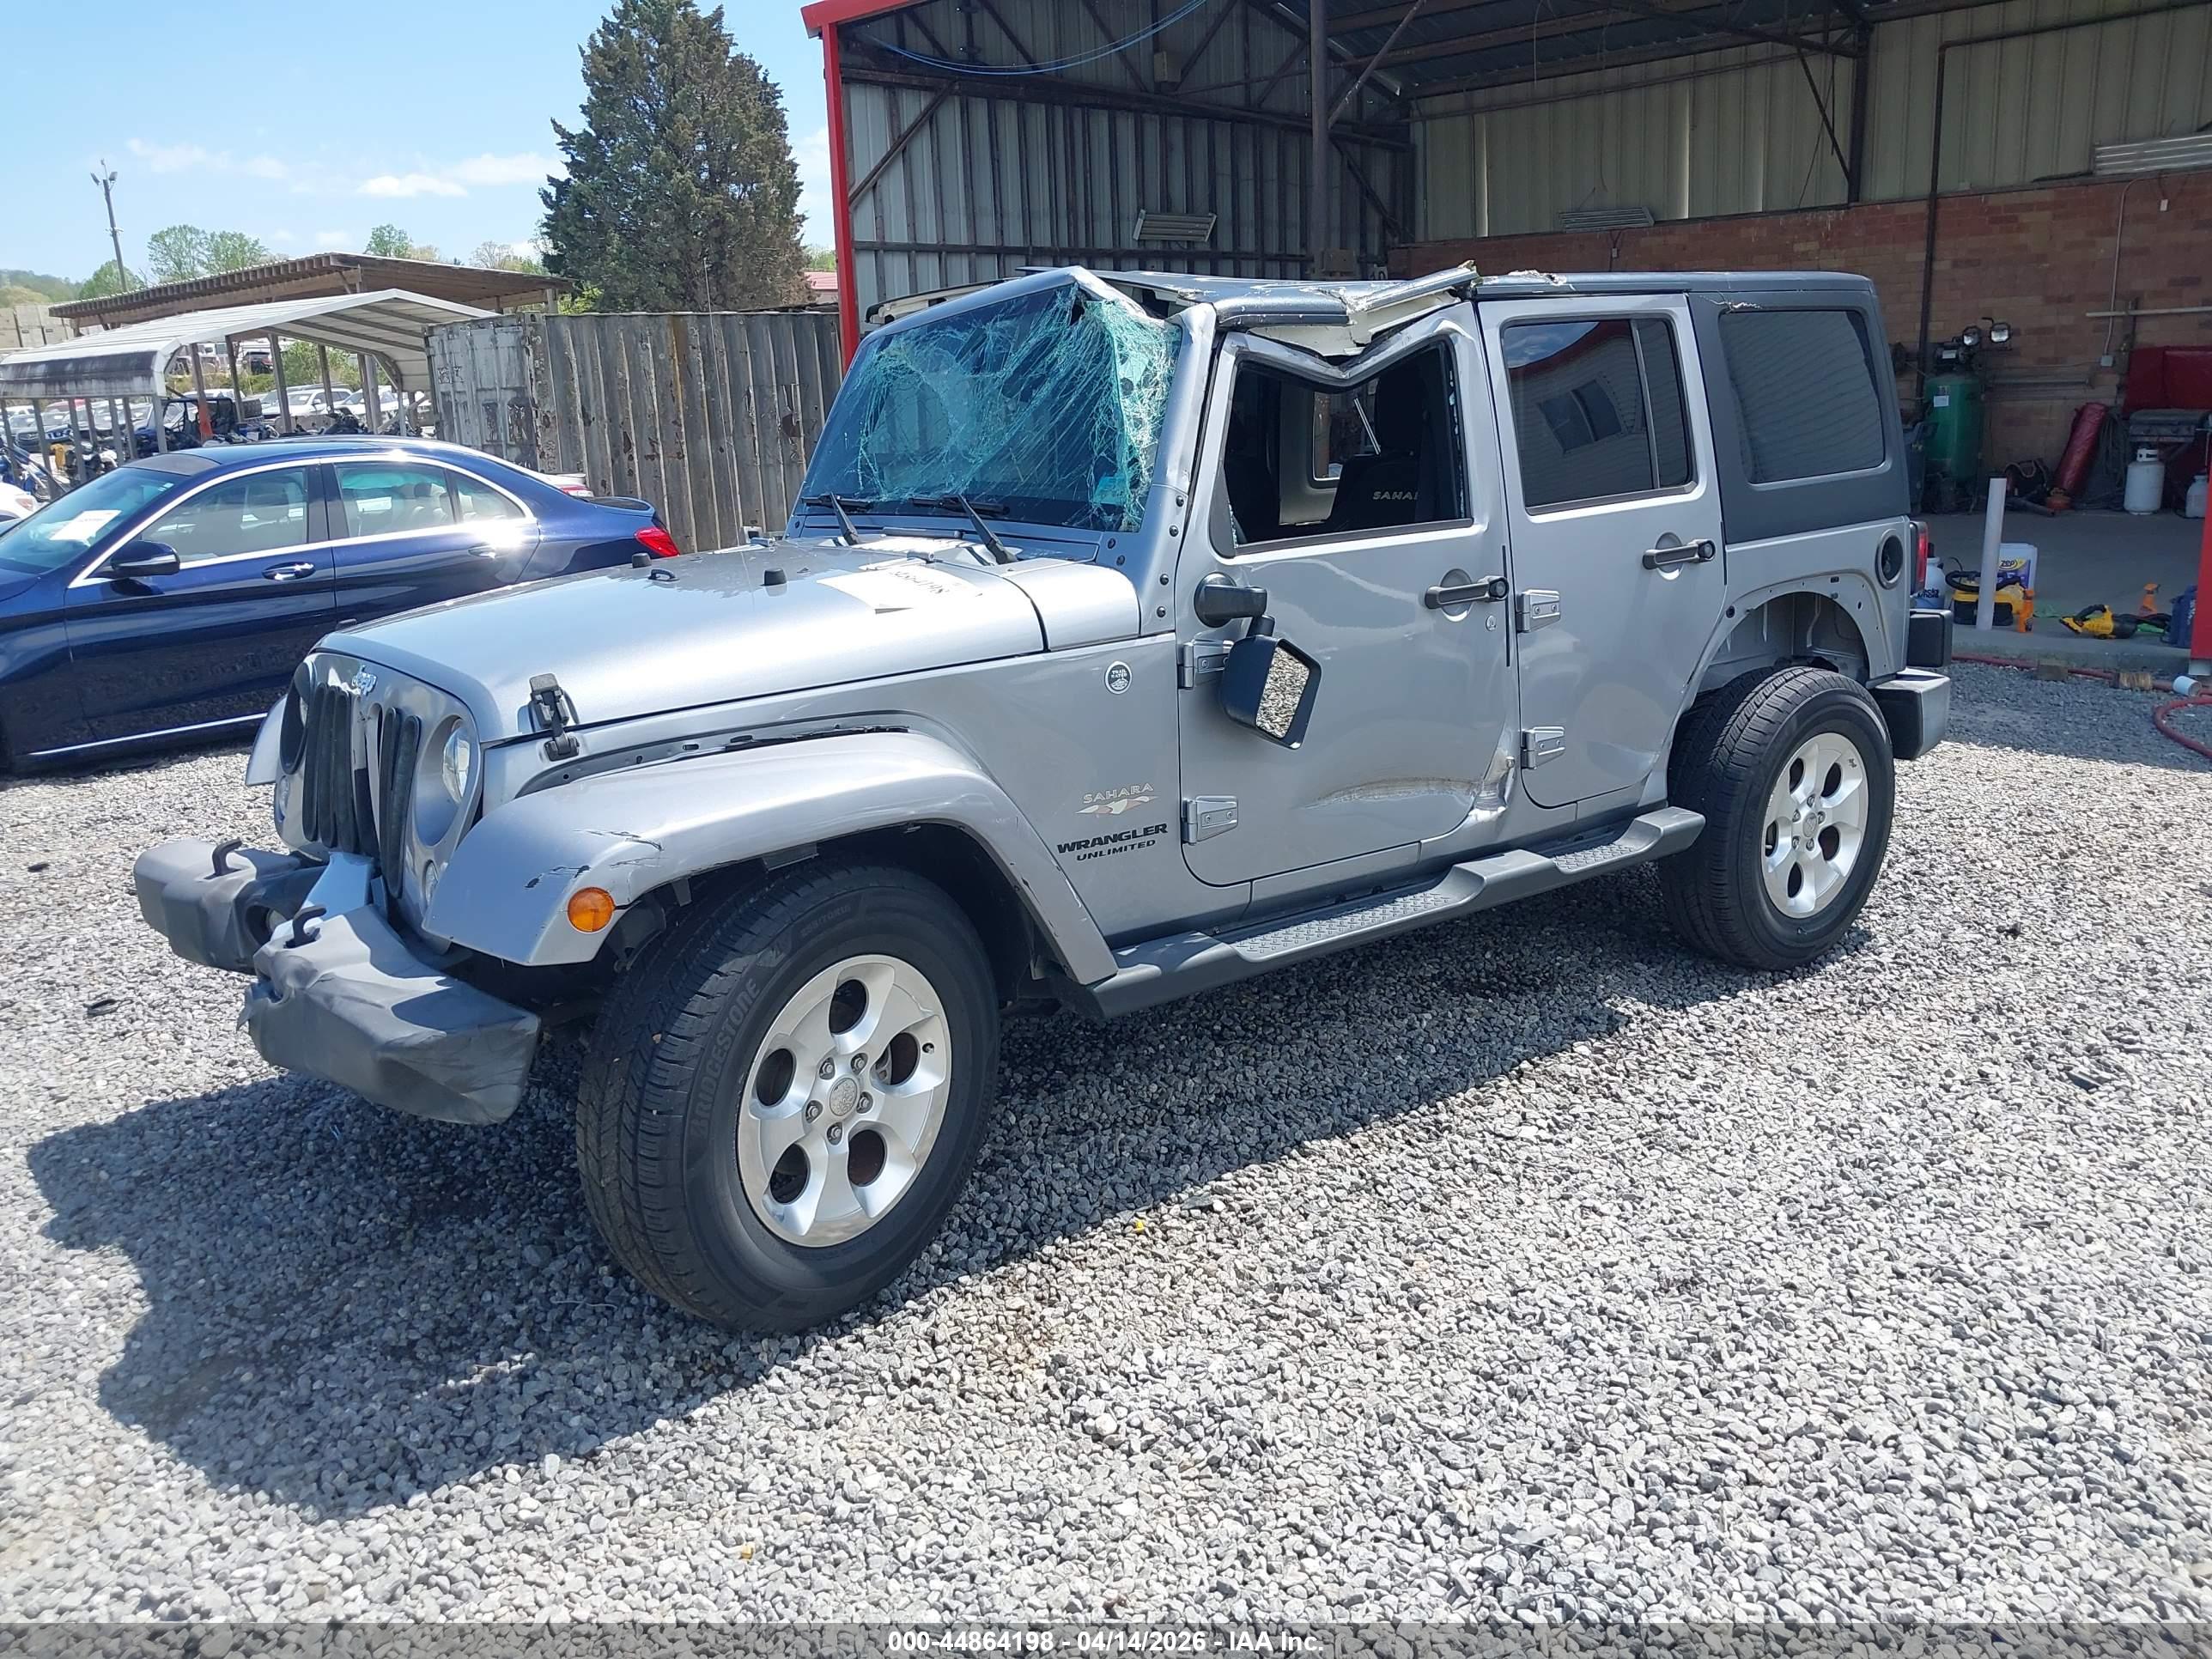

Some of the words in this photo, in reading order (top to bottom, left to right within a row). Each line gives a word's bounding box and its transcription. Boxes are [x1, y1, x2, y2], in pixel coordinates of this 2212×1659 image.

[1083, 782, 1154, 804] SAHARA
[1056, 823, 1168, 854] WRANGLER
[1076, 839, 1156, 861] UNLIMITED
[690, 977, 761, 1138] BRIDGESTONE
